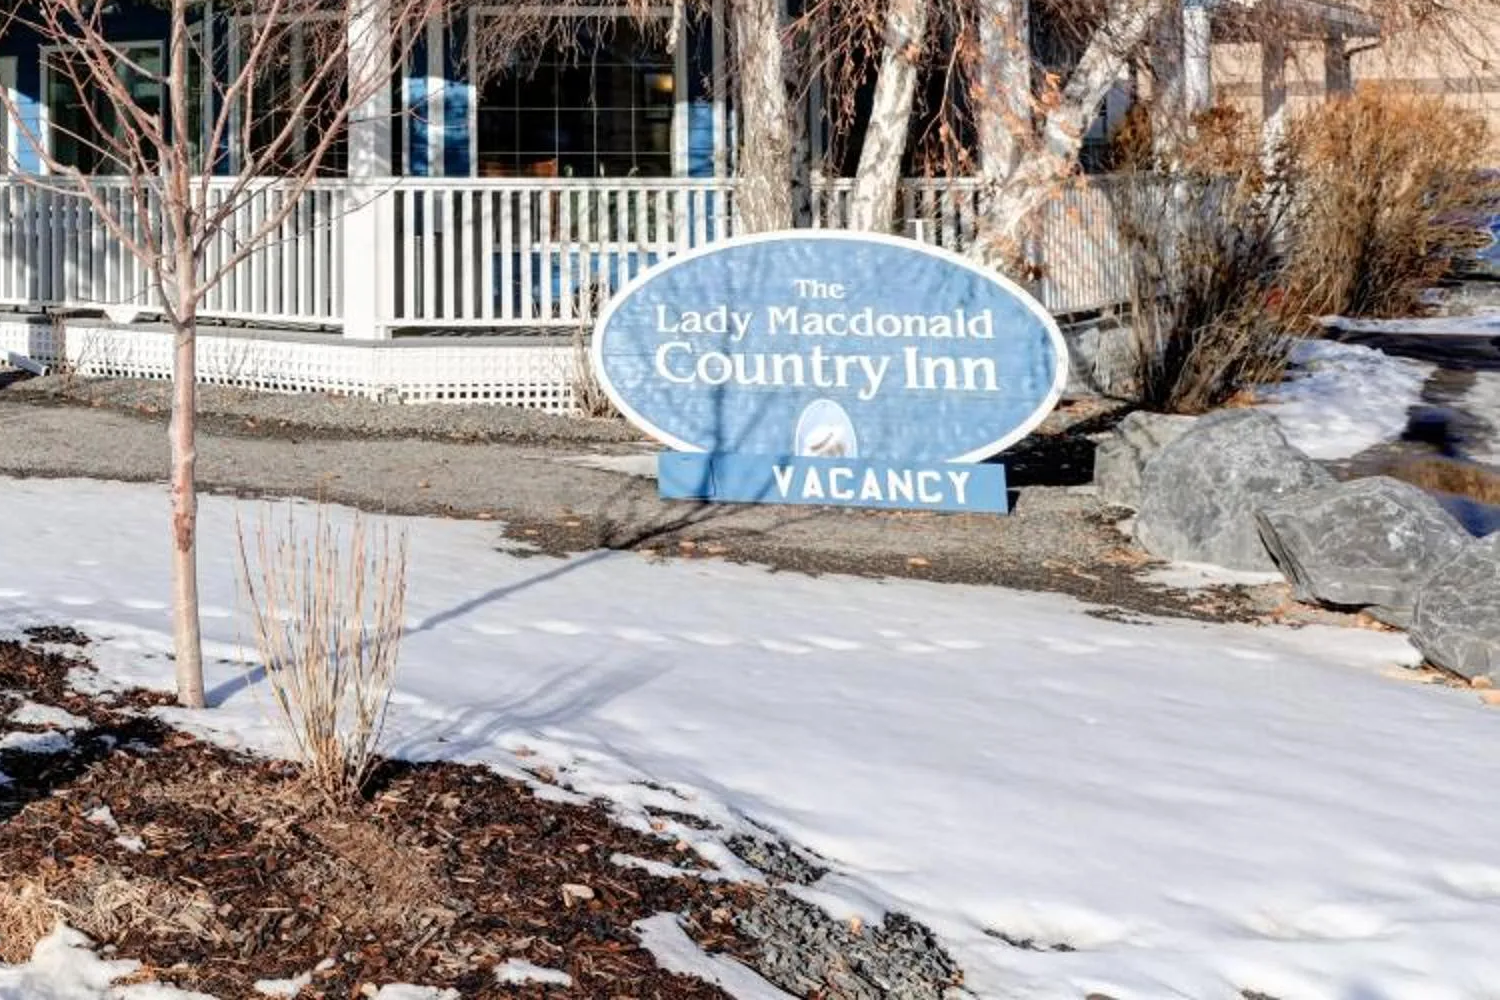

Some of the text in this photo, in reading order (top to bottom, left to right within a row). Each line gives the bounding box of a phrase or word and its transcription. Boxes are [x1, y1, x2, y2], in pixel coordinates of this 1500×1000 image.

[795, 280, 846, 298] The
[657, 305, 994, 339] Lady Macdonald
[656, 342, 998, 400] Country Inn
[773, 466, 971, 504] VACANCY
